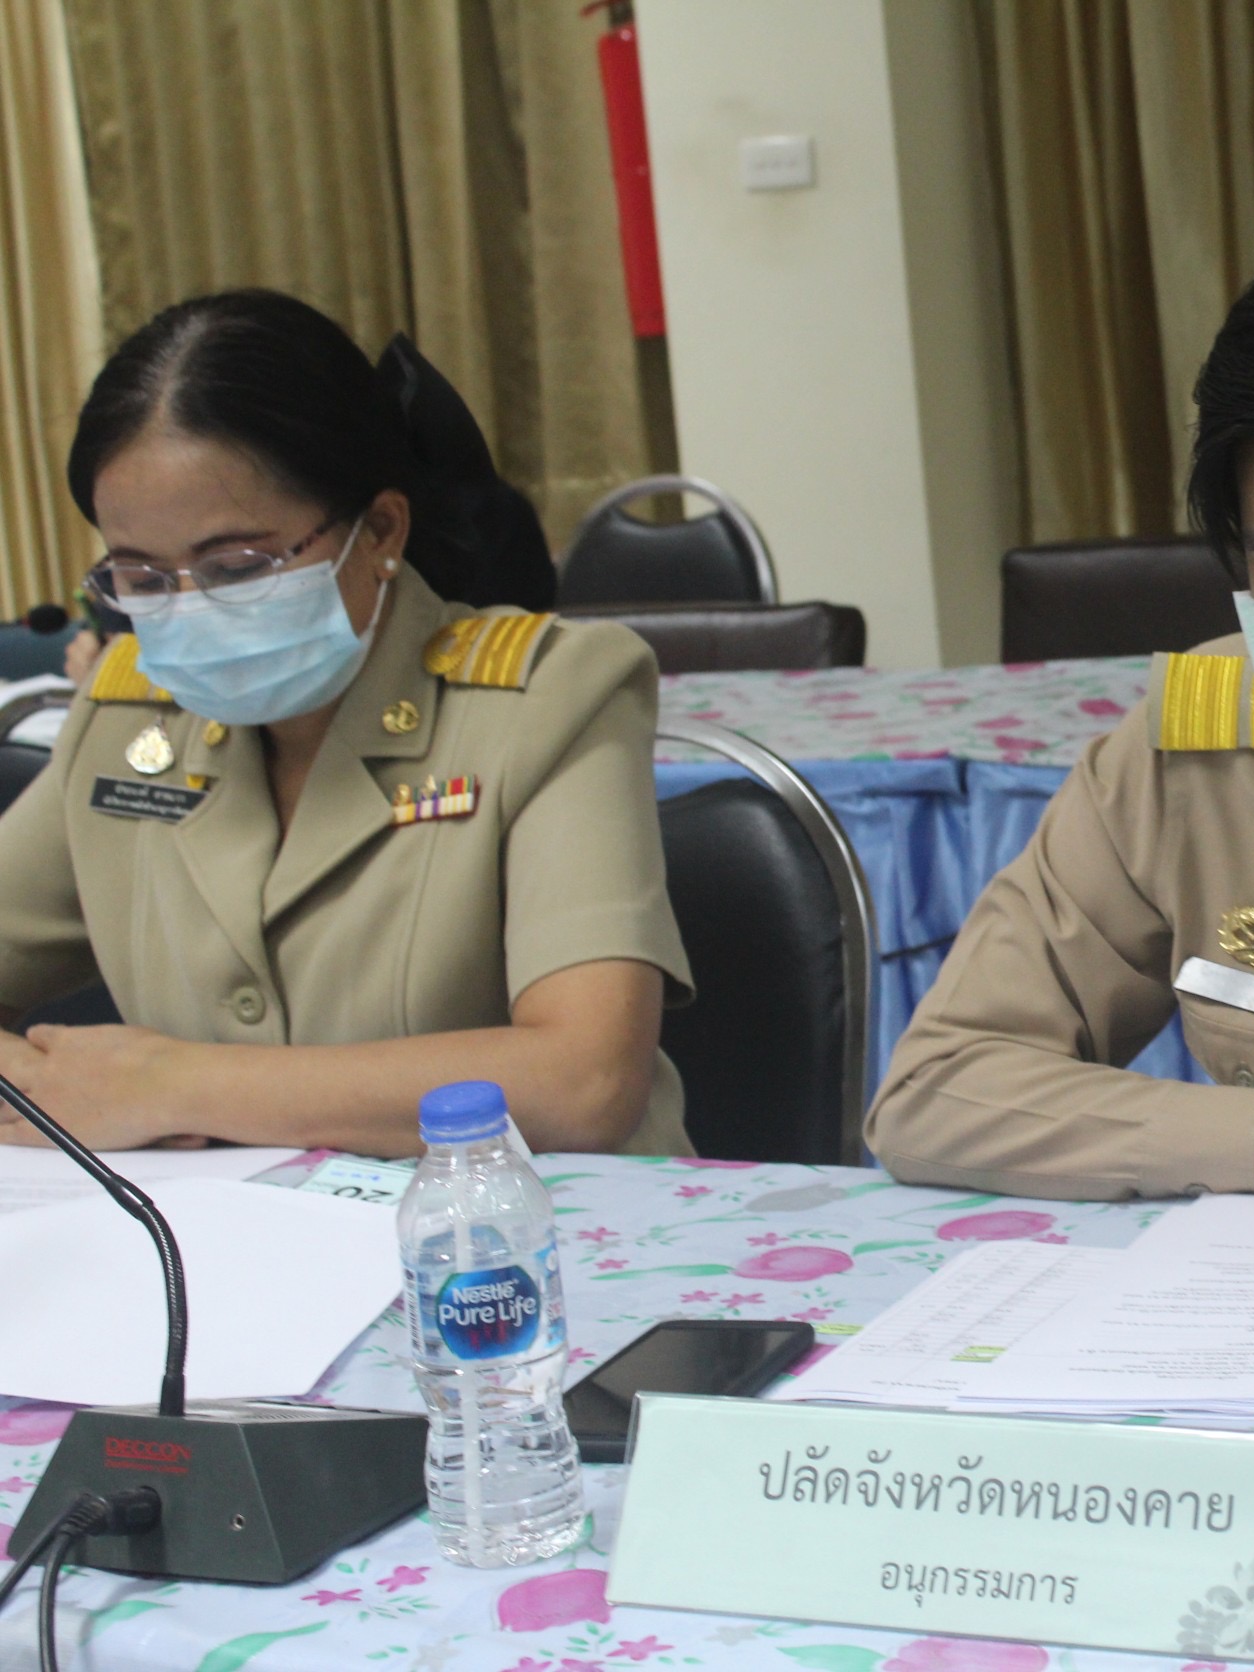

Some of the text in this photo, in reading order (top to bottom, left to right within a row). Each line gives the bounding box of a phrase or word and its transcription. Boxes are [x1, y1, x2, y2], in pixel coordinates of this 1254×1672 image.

[438, 1302, 496, 1327] Pure
[499, 1296, 537, 1328] Life
[758, 1444, 1236, 1533] ปลัดจังหวัดหนองคาย
[879, 1559, 1079, 1608] อนุกรรมการ
